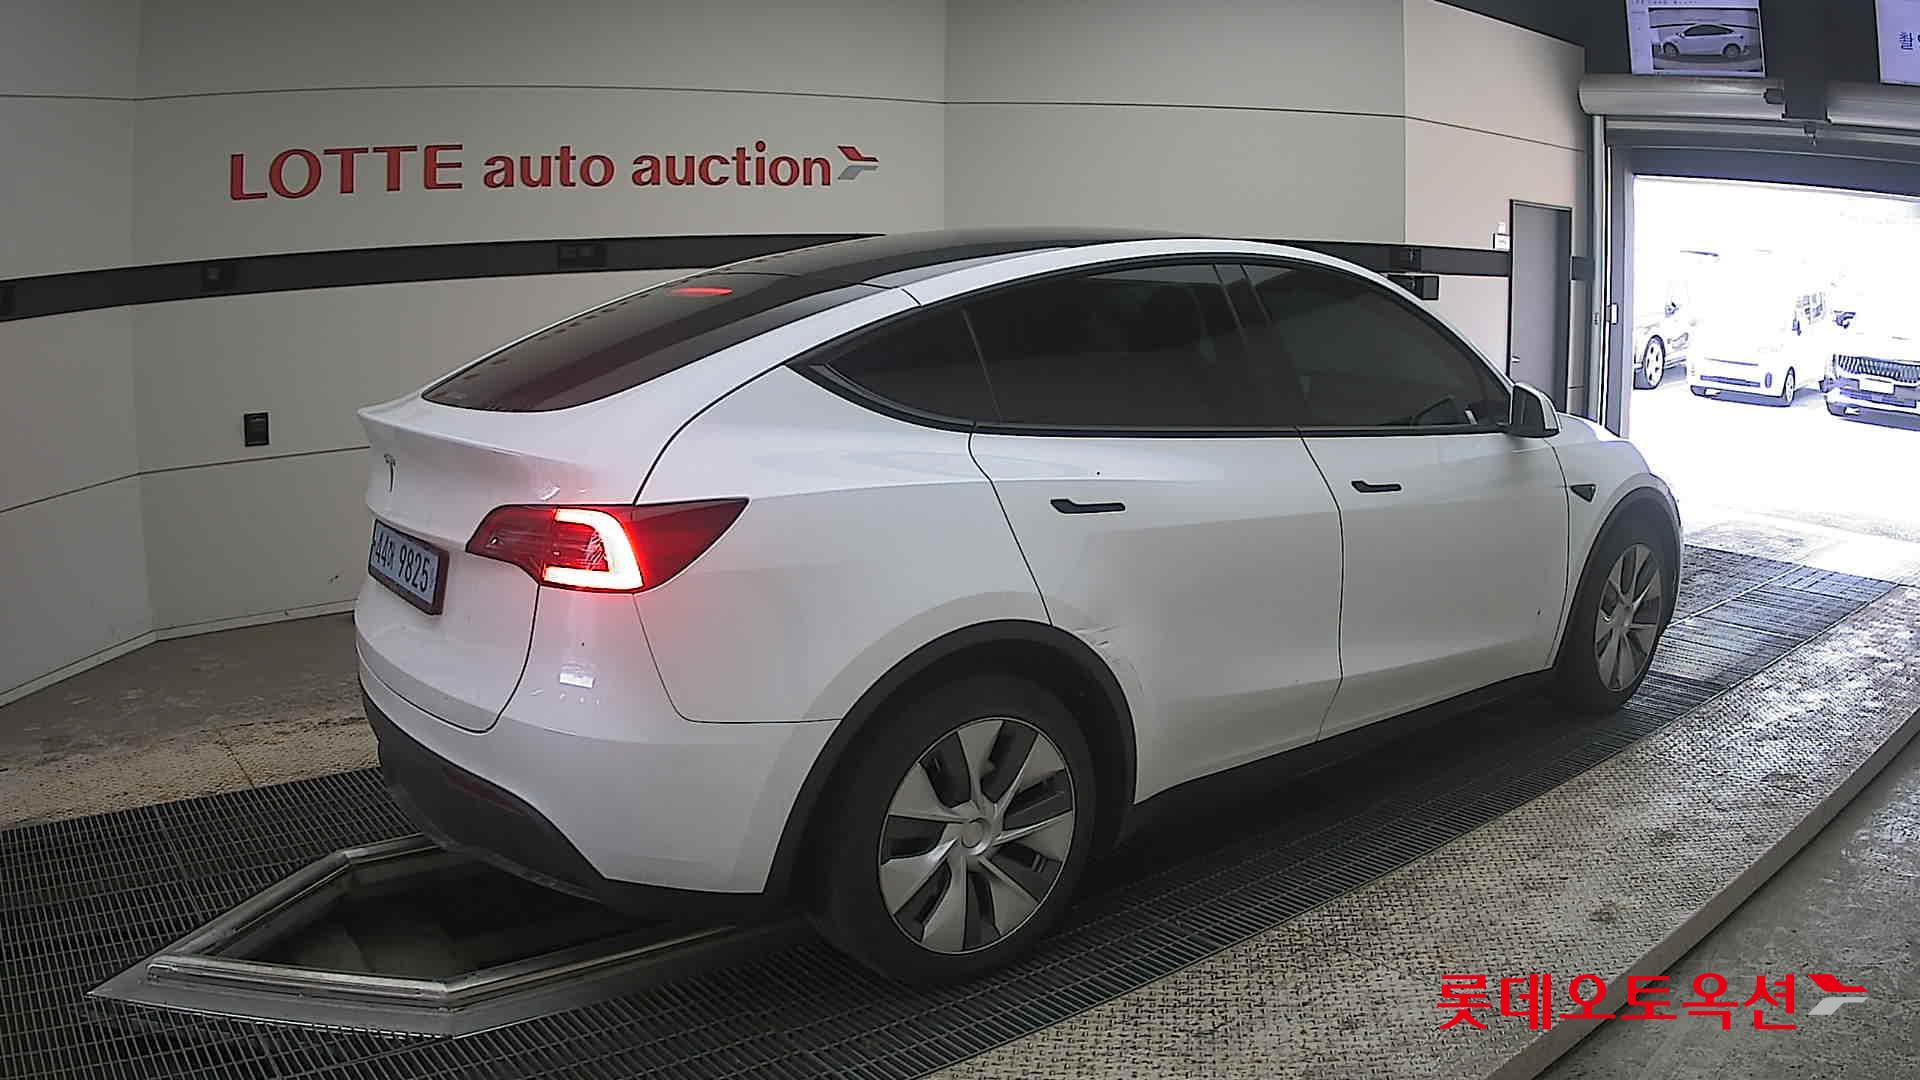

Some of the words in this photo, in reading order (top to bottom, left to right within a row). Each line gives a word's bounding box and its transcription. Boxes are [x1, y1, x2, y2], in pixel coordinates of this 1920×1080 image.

[230, 144, 464, 200] LOTTE
[483, 144, 614, 188] auto
[631, 140, 832, 186] auction
[398, 544, 431, 593] 9825
